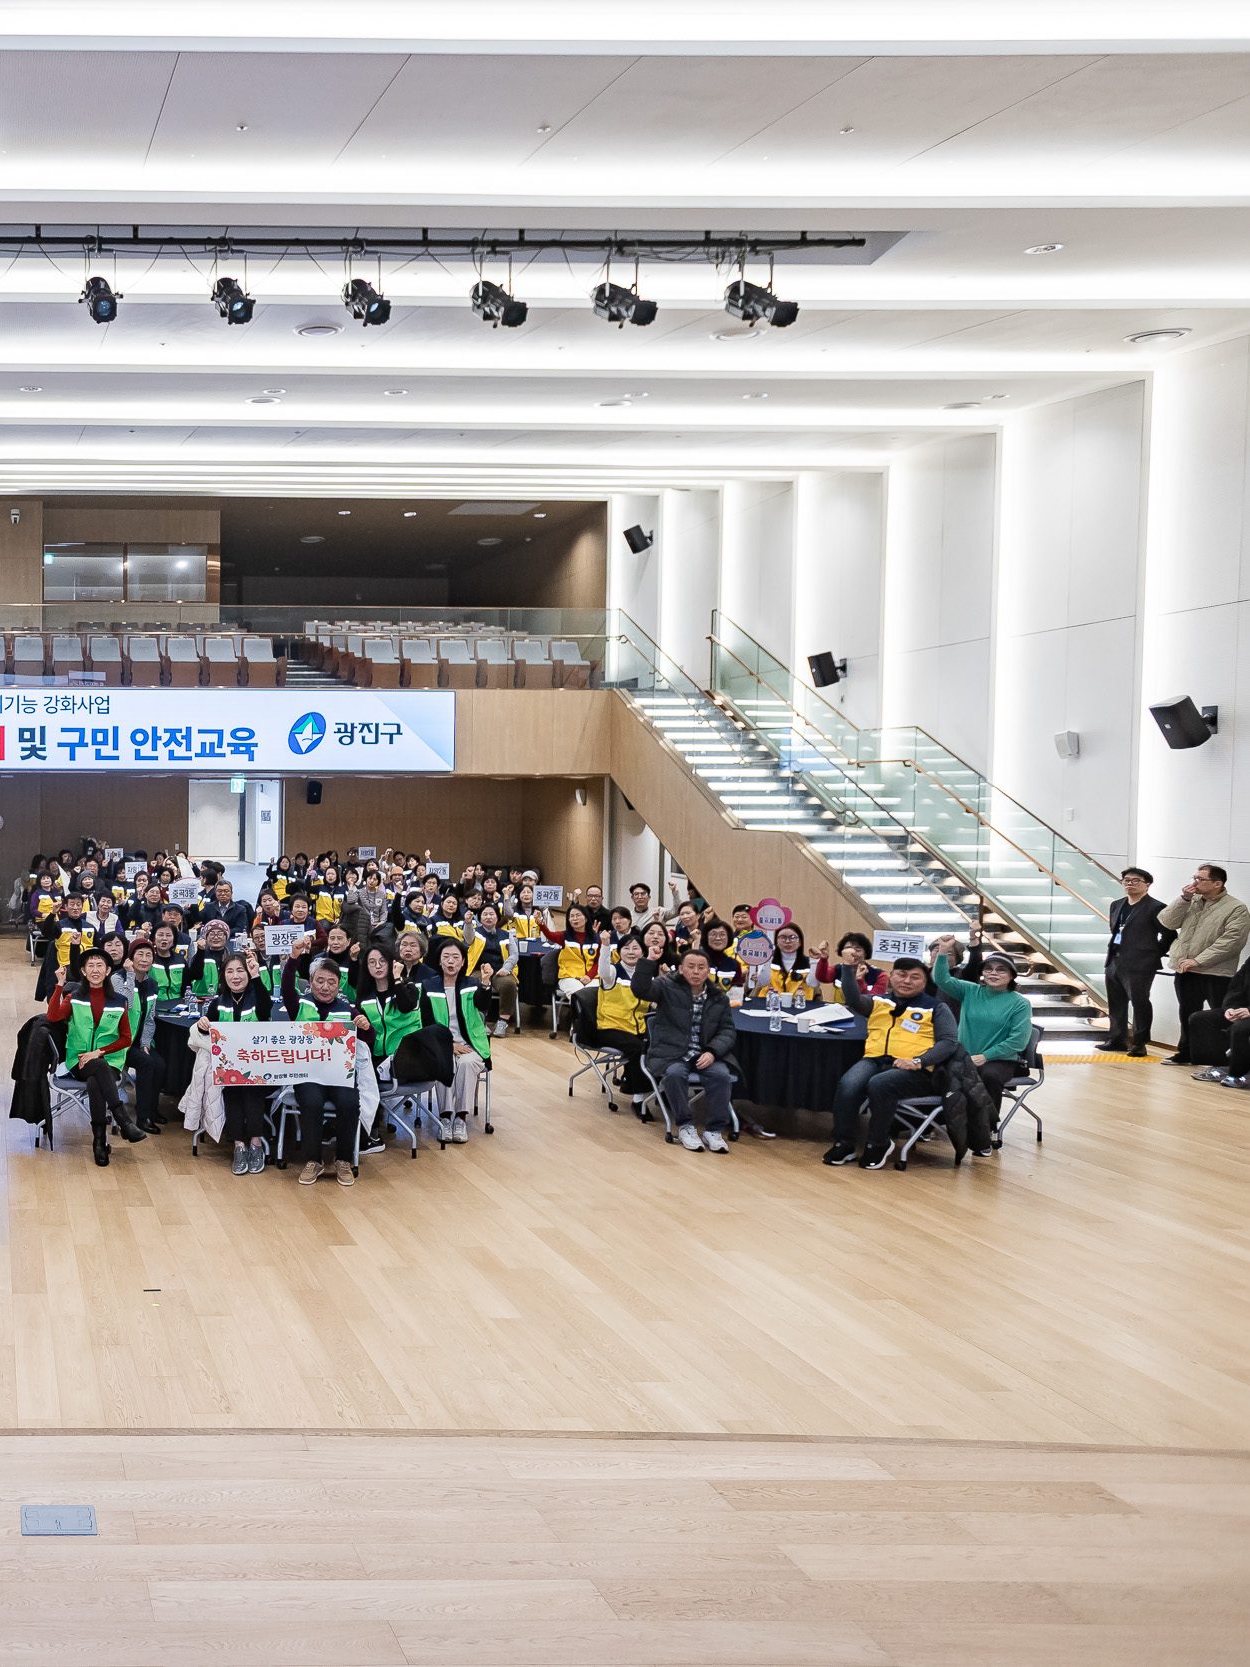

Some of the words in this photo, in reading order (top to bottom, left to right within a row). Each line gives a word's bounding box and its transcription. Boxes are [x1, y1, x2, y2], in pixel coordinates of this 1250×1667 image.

[43, 694, 110, 714] 강화사업
[333, 722, 403, 746] 광진구
[18, 725, 48, 761] 및
[56, 725, 120, 761] 구민
[129, 725, 259, 762] 안전교육
[172, 889, 195, 899] 중곡3동
[536, 890, 560, 901] 중곡2동
[878, 938, 920, 954] 중곡1동
[251, 1035, 268, 1045] 살기
[270, 1035, 287, 1045] 좋은
[288, 1035, 314, 1045] 광장동
[236, 1048, 332, 1064] 축하드립니다!
